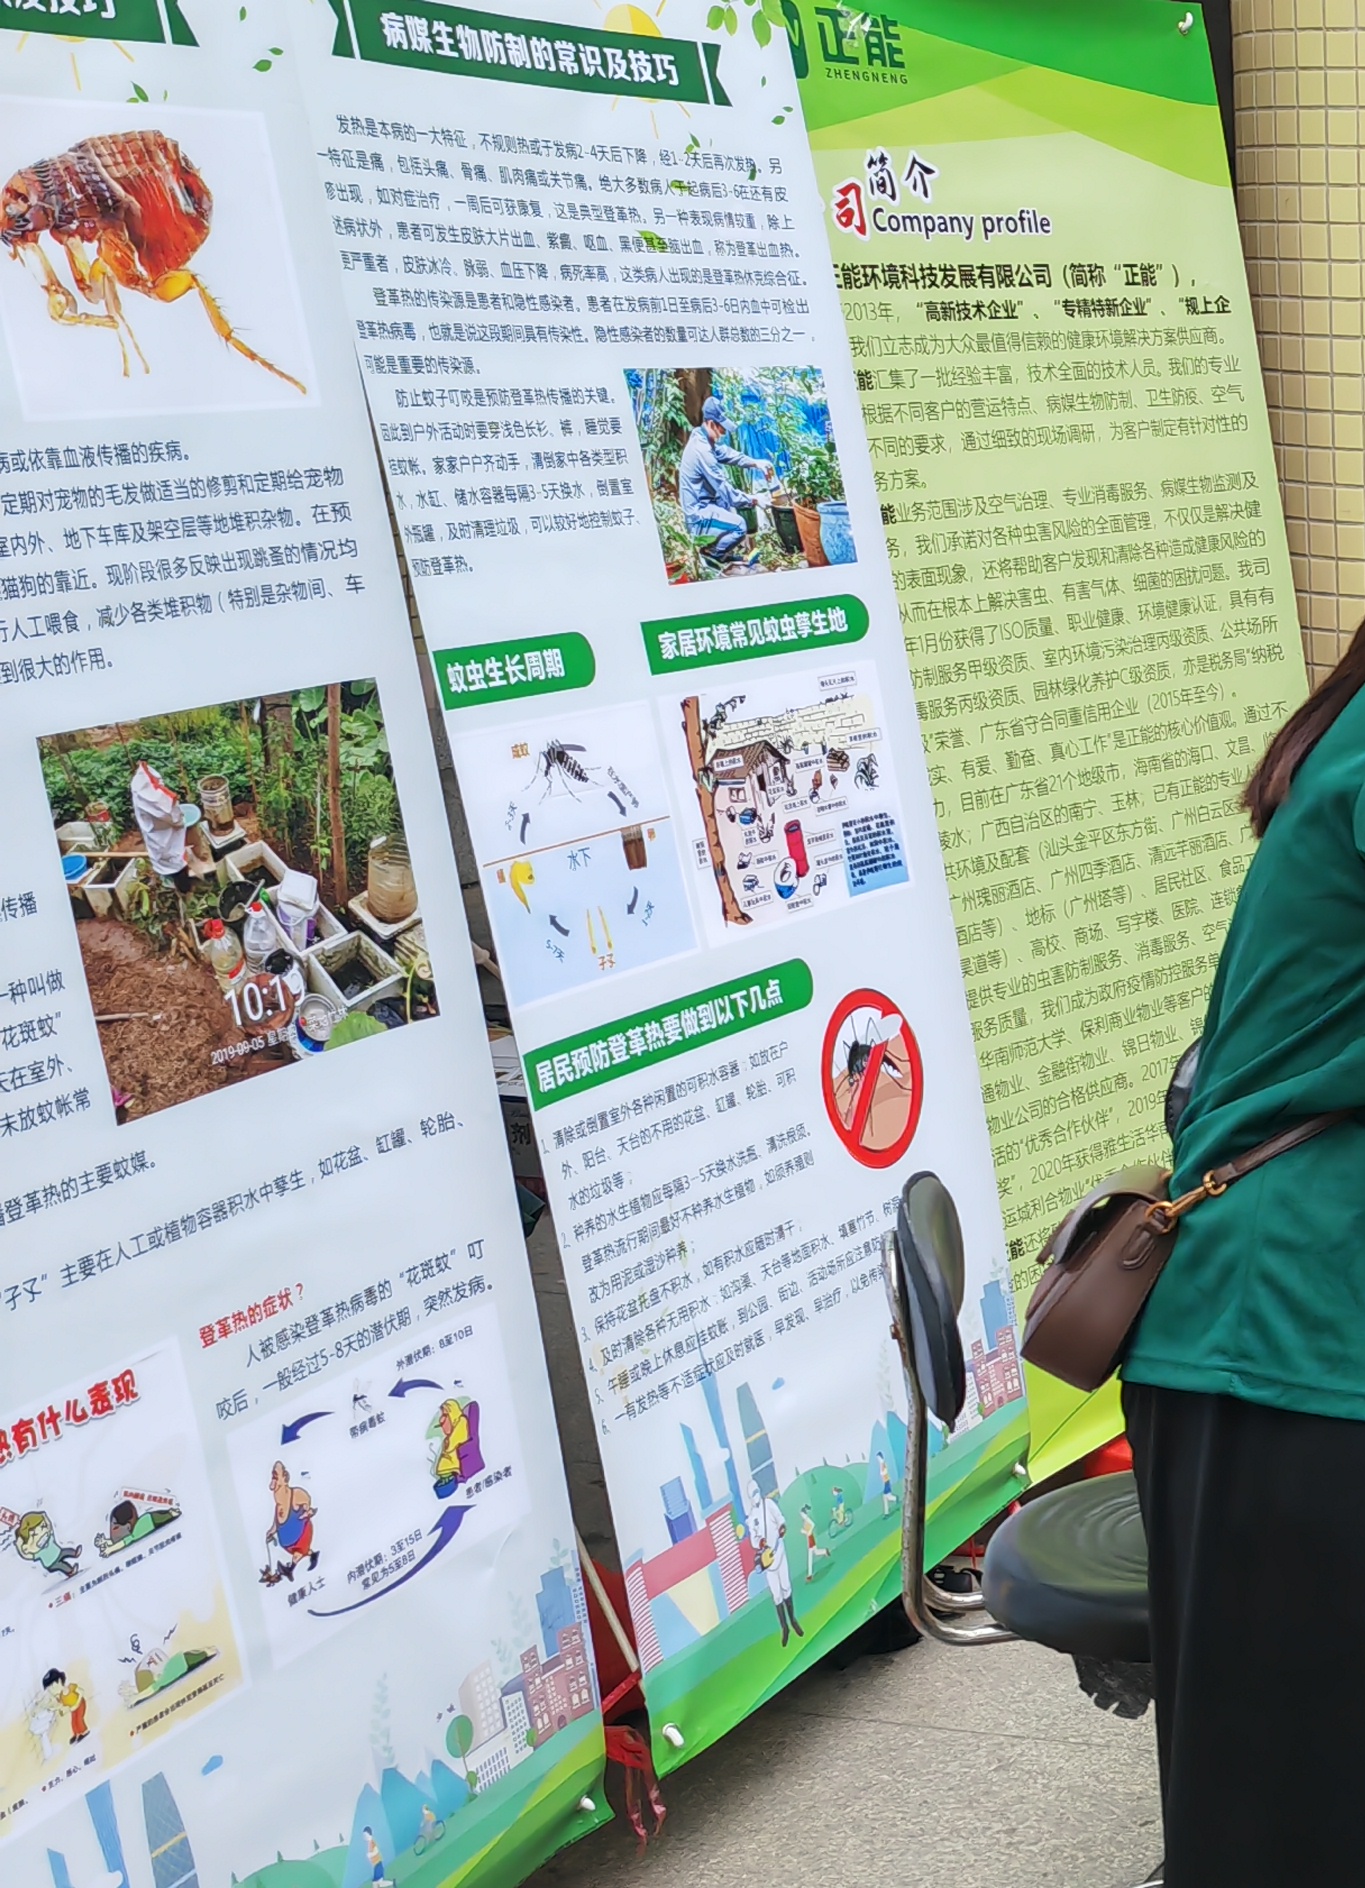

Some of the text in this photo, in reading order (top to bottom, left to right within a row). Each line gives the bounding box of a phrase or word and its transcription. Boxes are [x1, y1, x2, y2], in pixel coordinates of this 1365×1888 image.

[380, 11, 680, 86] 病媒生物防制的常识及技巧
[817, 6, 906, 69] 正能
[825, 67, 909, 85] ZHENGNENG
[872, 207, 1052, 241] Company profile
[0, 539, 358, 600] 猫狗的靠近。现阶段很多反映出现跳蚤的情况均
[0, 648, 114, 686] 到很大的作用。
[446, 648, 566, 694] 蚊虫生长周期
[535, 978, 785, 1095] 居民预防登革热要做到以下几点
